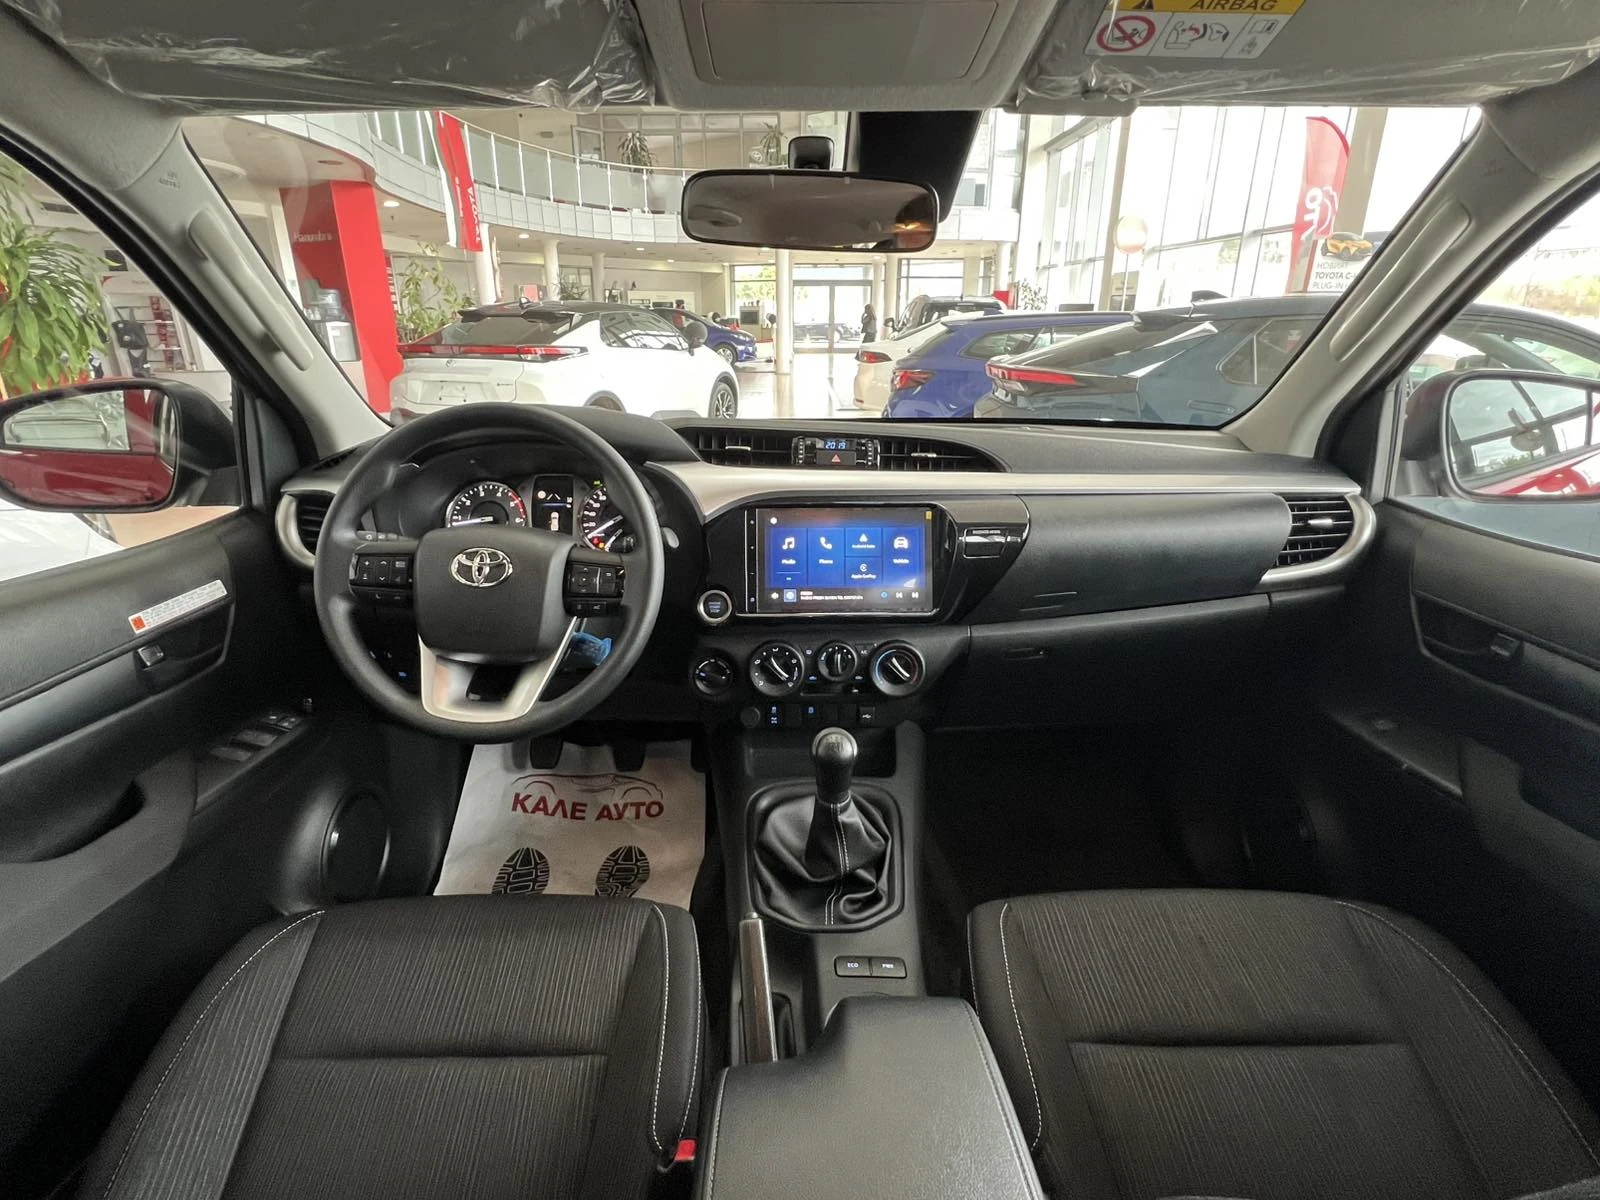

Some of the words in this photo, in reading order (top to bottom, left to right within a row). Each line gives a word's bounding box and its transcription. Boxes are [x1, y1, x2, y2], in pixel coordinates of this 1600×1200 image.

[1189, 0, 1278, 11] AIRBAG
[1314, 271, 1344, 280] TOYOTA
[510, 792, 588, 821] КАЛЕ
[595, 800, 665, 822] АУТО
